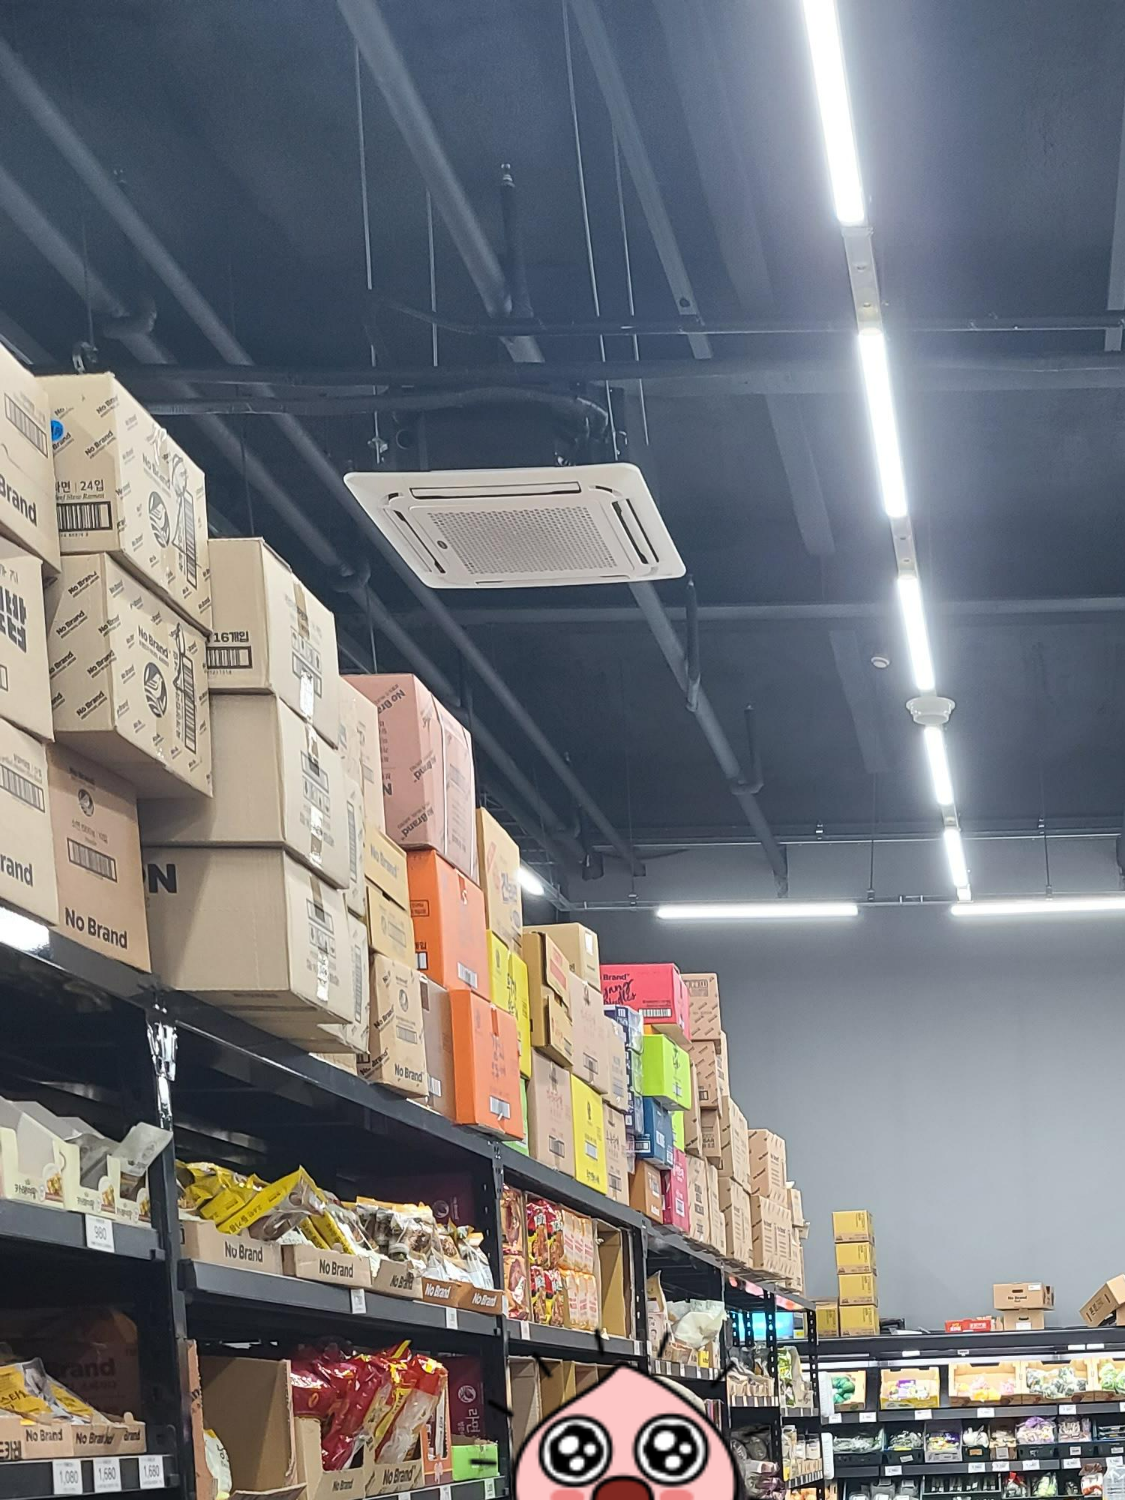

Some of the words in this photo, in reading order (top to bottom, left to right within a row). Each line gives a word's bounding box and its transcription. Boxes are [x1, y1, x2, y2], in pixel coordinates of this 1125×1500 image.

[94, 431, 114, 450] Brand
[68, 582, 79, 595] No
[77, 571, 98, 591] Brand
[56, 624, 68, 636] No
[66, 610, 85, 630] Brand
[96, 650, 115, 671] Brand
[76, 704, 87, 717] No
[85, 690, 105, 712] Brand
[65, 907, 85, 932] No
[87, 917, 128, 950] Brand
[94, 1225, 107, 1241] 980
[225, 1241, 238, 1258] No
[239, 1244, 263, 1263] Brand
[319, 1258, 331, 1276] No
[331, 1261, 353, 1279] Brand
[26, 1429, 39, 1443] No
[40, 1428, 64, 1443] Brand
[75, 1431, 88, 1446] No
[59, 1470, 79, 1486] 1,080
[382, 1467, 395, 1485] No
[394, 1466, 414, 1485] Brand
